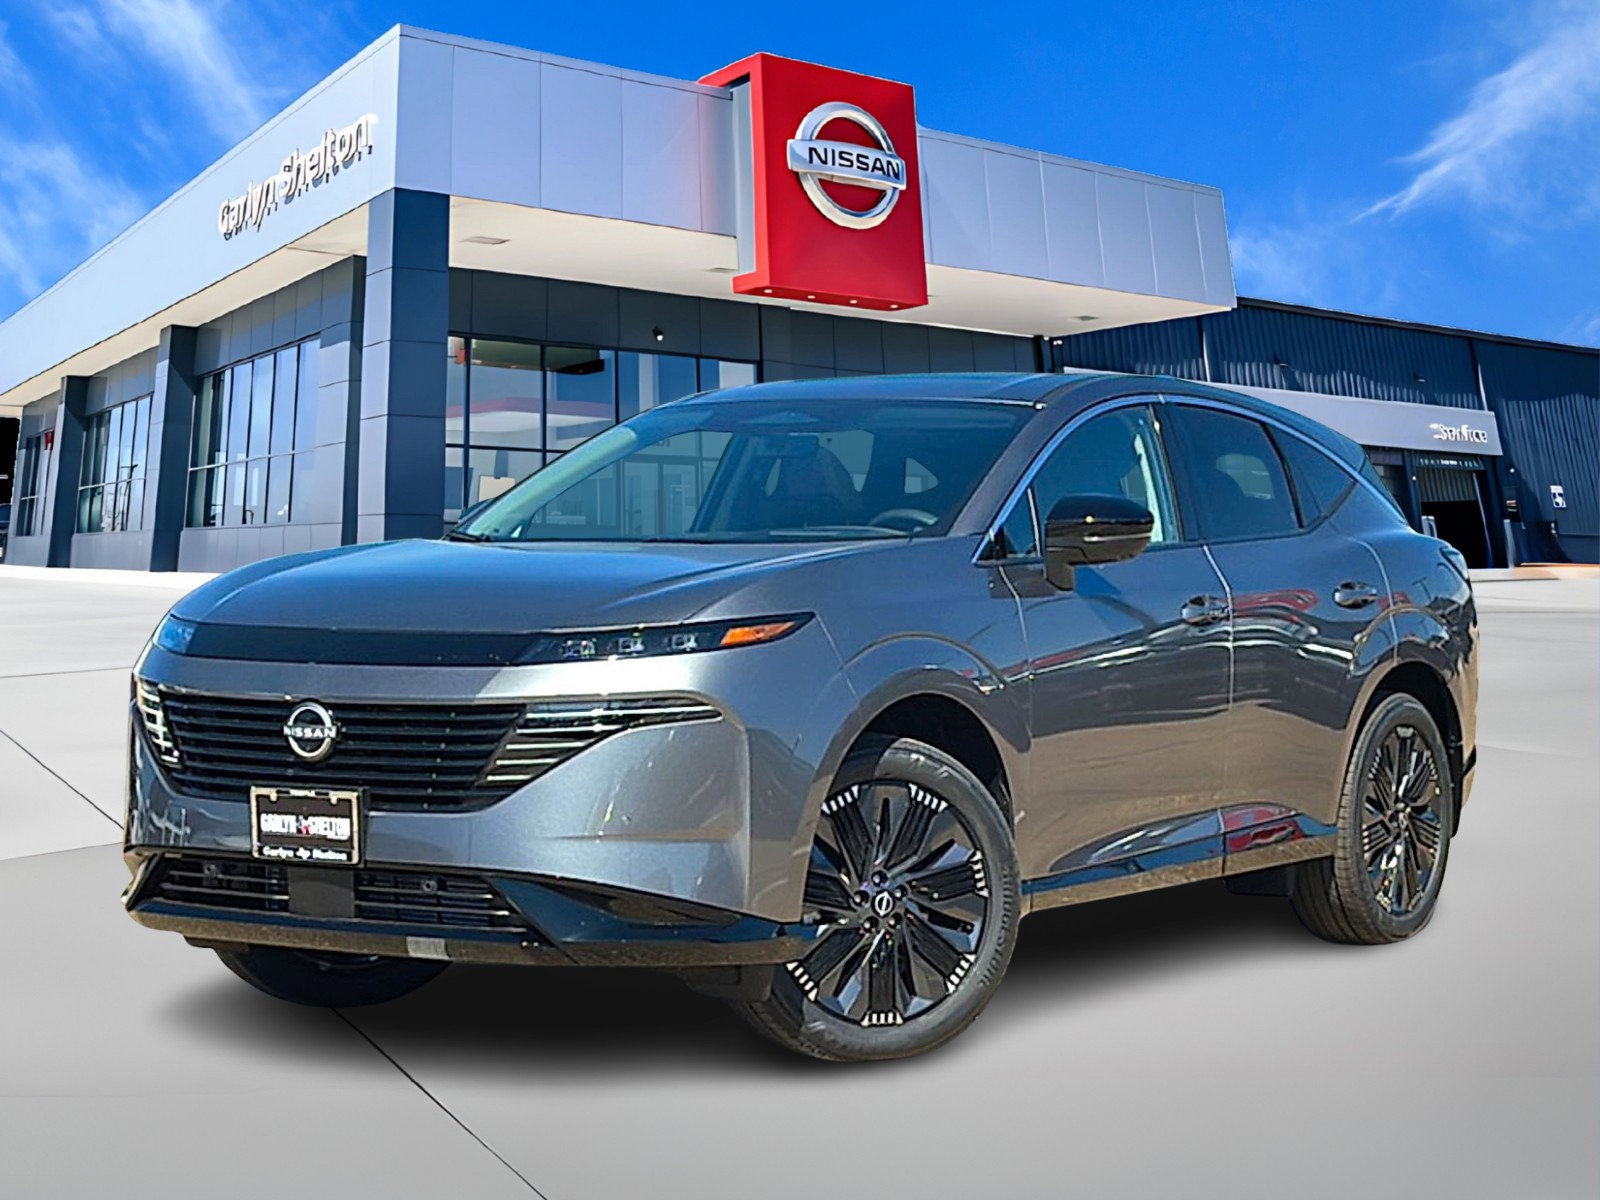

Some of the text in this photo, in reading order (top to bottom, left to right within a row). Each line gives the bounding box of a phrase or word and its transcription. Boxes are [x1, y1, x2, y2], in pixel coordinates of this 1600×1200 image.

[278, 113, 374, 205] Shelton
[807, 146, 900, 181] NISSAN
[283, 724, 338, 739] NISSAN
